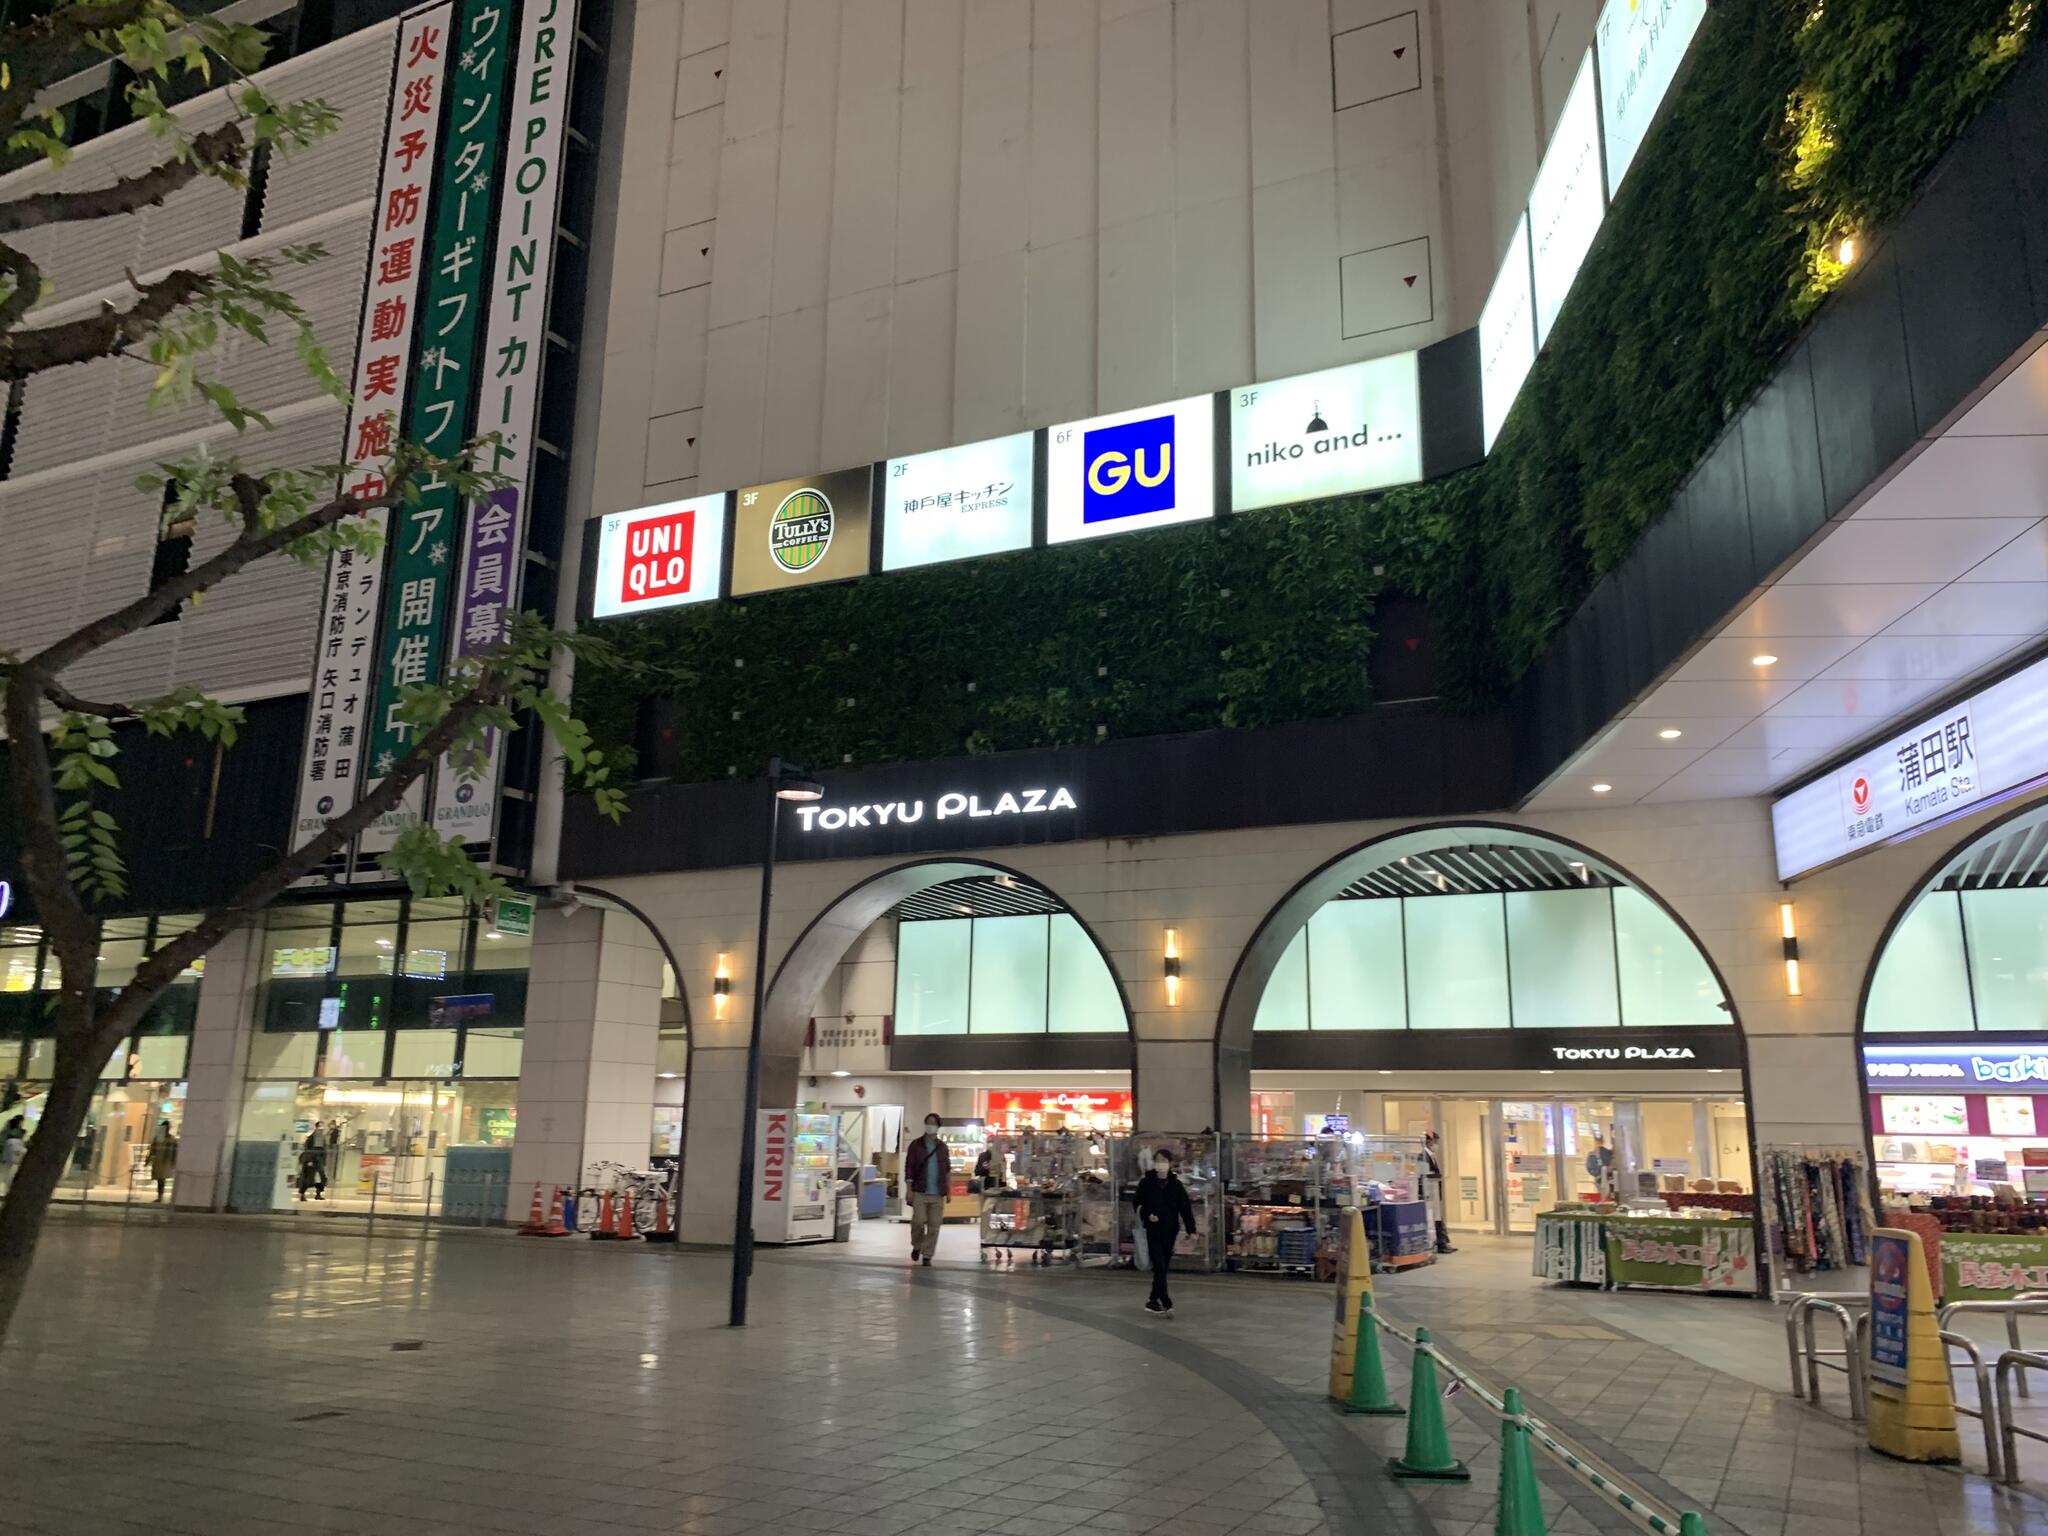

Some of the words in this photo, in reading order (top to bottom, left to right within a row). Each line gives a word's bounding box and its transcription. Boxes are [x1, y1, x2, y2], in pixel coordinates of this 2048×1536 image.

[1239, 391, 1259, 408] 3F
[1056, 430, 1073, 444] 6F
[1247, 442, 1304, 467] niko
[1313, 424, 1369, 454] and
[893, 464, 909, 477] 2F
[1088, 442, 1171, 496] GU
[743, 492, 759, 506] 3F
[903, 481, 1014, 513] 神戸屋キッチン
[960, 497, 1008, 513] EXPRESS
[607, 520, 621, 532] 5F
[632, 522, 683, 558] UNI
[783, 534, 819, 547] COFFEE
[629, 556, 685, 595] QLO
[334, 551, 375, 780] ランデュオ蒲田
[1897, 716, 1973, 791] 蒲田駅
[796, 800, 924, 832] TOKYU
[936, 788, 1078, 820] PLAZA
[1904, 785, 1949, 817] Kamata
[1951, 775, 1976, 798] Sta.
[1847, 812, 1884, 841] 東急電鉄
[1553, 1047, 1620, 1060] TOKYU
[1624, 1047, 1695, 1060] PLAZA
[763, 1114, 787, 1202] KIRIN
